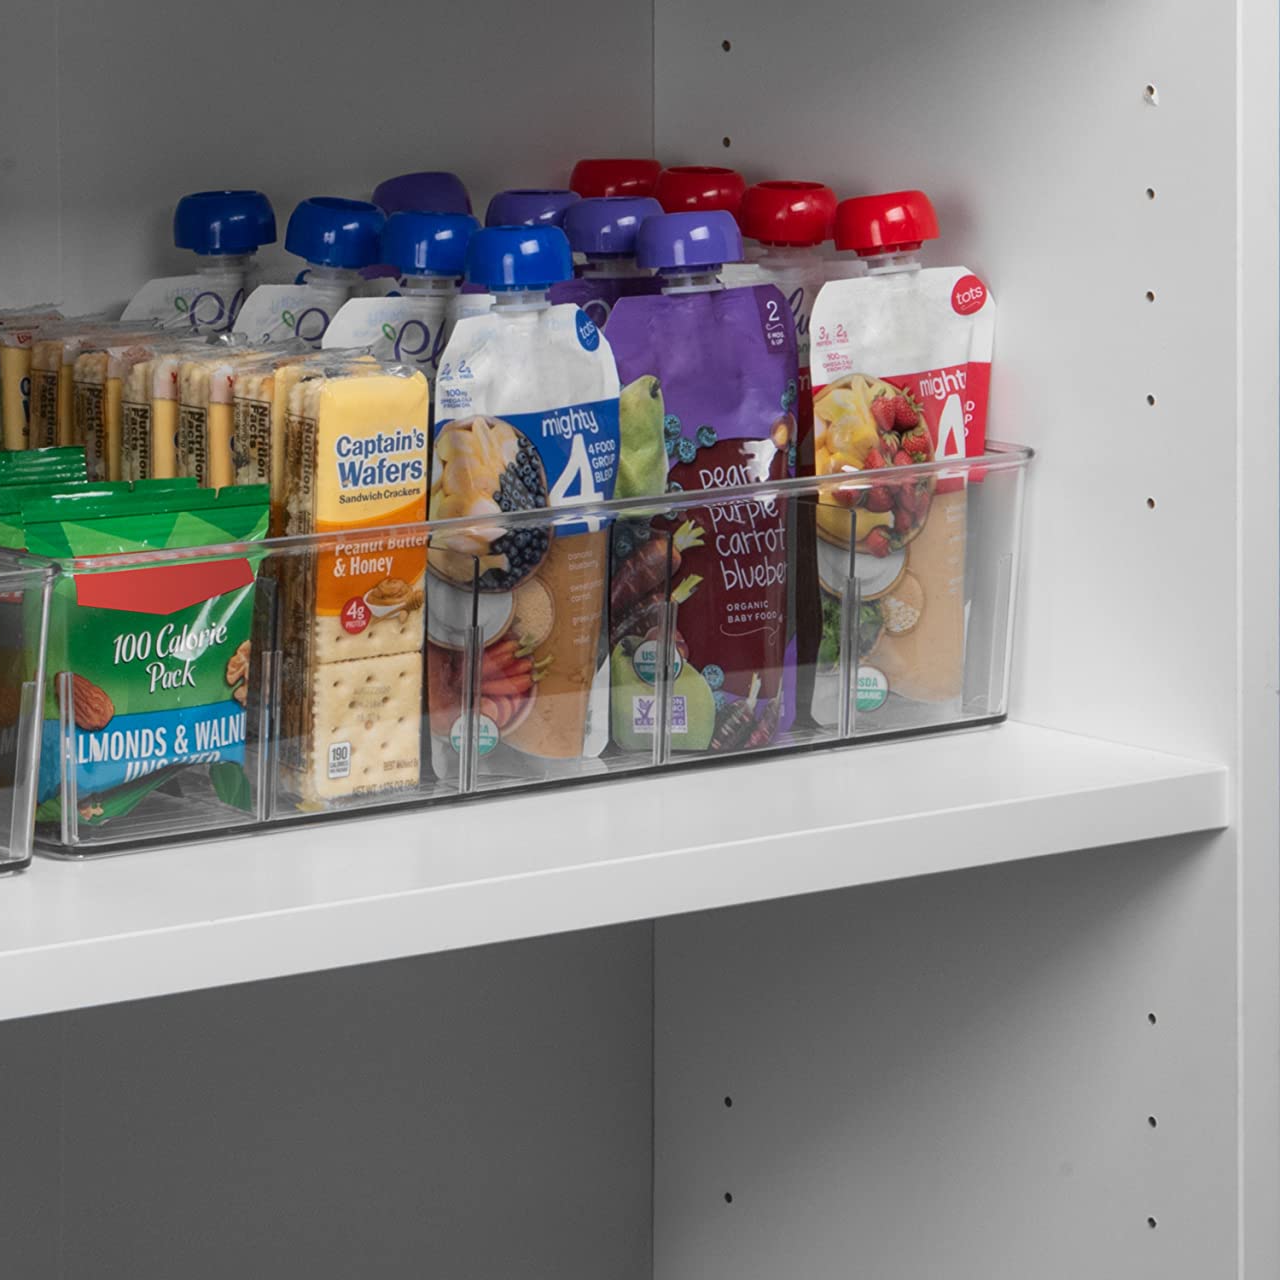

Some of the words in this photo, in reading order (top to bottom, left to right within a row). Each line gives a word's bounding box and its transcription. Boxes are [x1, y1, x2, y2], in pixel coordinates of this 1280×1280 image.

[766, 300, 780, 321] 2
[956, 285, 984, 306] tots
[580, 319, 597, 339] tots
[920, 370, 966, 400] might
[46, 376, 57, 445] Nutrition
[85, 387, 94, 431] Facts
[94, 388, 104, 458] Nutrition
[542, 409, 600, 439] mighty
[131, 408, 139, 451] Facts
[187, 411, 195, 454] Facts
[250, 405, 258, 449] Facts
[257, 406, 268, 478] Nutrition
[138, 408, 149, 479] Nutrition
[195, 411, 205, 483] Nutrition
[302, 422, 313, 495] Nutrition
[336, 428, 425, 459] Captain's
[588, 444, 595, 455] 4
[595, 440, 616, 454] FOOD
[337, 458, 423, 489] Wafers
[592, 454, 615, 469] GROUP
[339, 492, 383, 505] Sandwich
[384, 488, 420, 499] Crackers
[335, 541, 385, 556] Peanut
[387, 536, 428, 551] Butter
[715, 520, 786, 557] carrot
[334, 558, 346, 577] &
[350, 556, 393, 577] Honey
[346, 600, 365, 620] 4g
[727, 600, 769, 612] ORGANIC
[728, 612, 753, 624] BABY
[755, 611, 777, 621] FOOD
[113, 631, 152, 665] 100
[156, 621, 228, 659] Calorie
[145, 659, 196, 693] Pack
[858, 677, 878, 687] SDA
[174, 724, 189, 754] &
[194, 711, 246, 751] WALNU
[332, 746, 348, 760] 190
